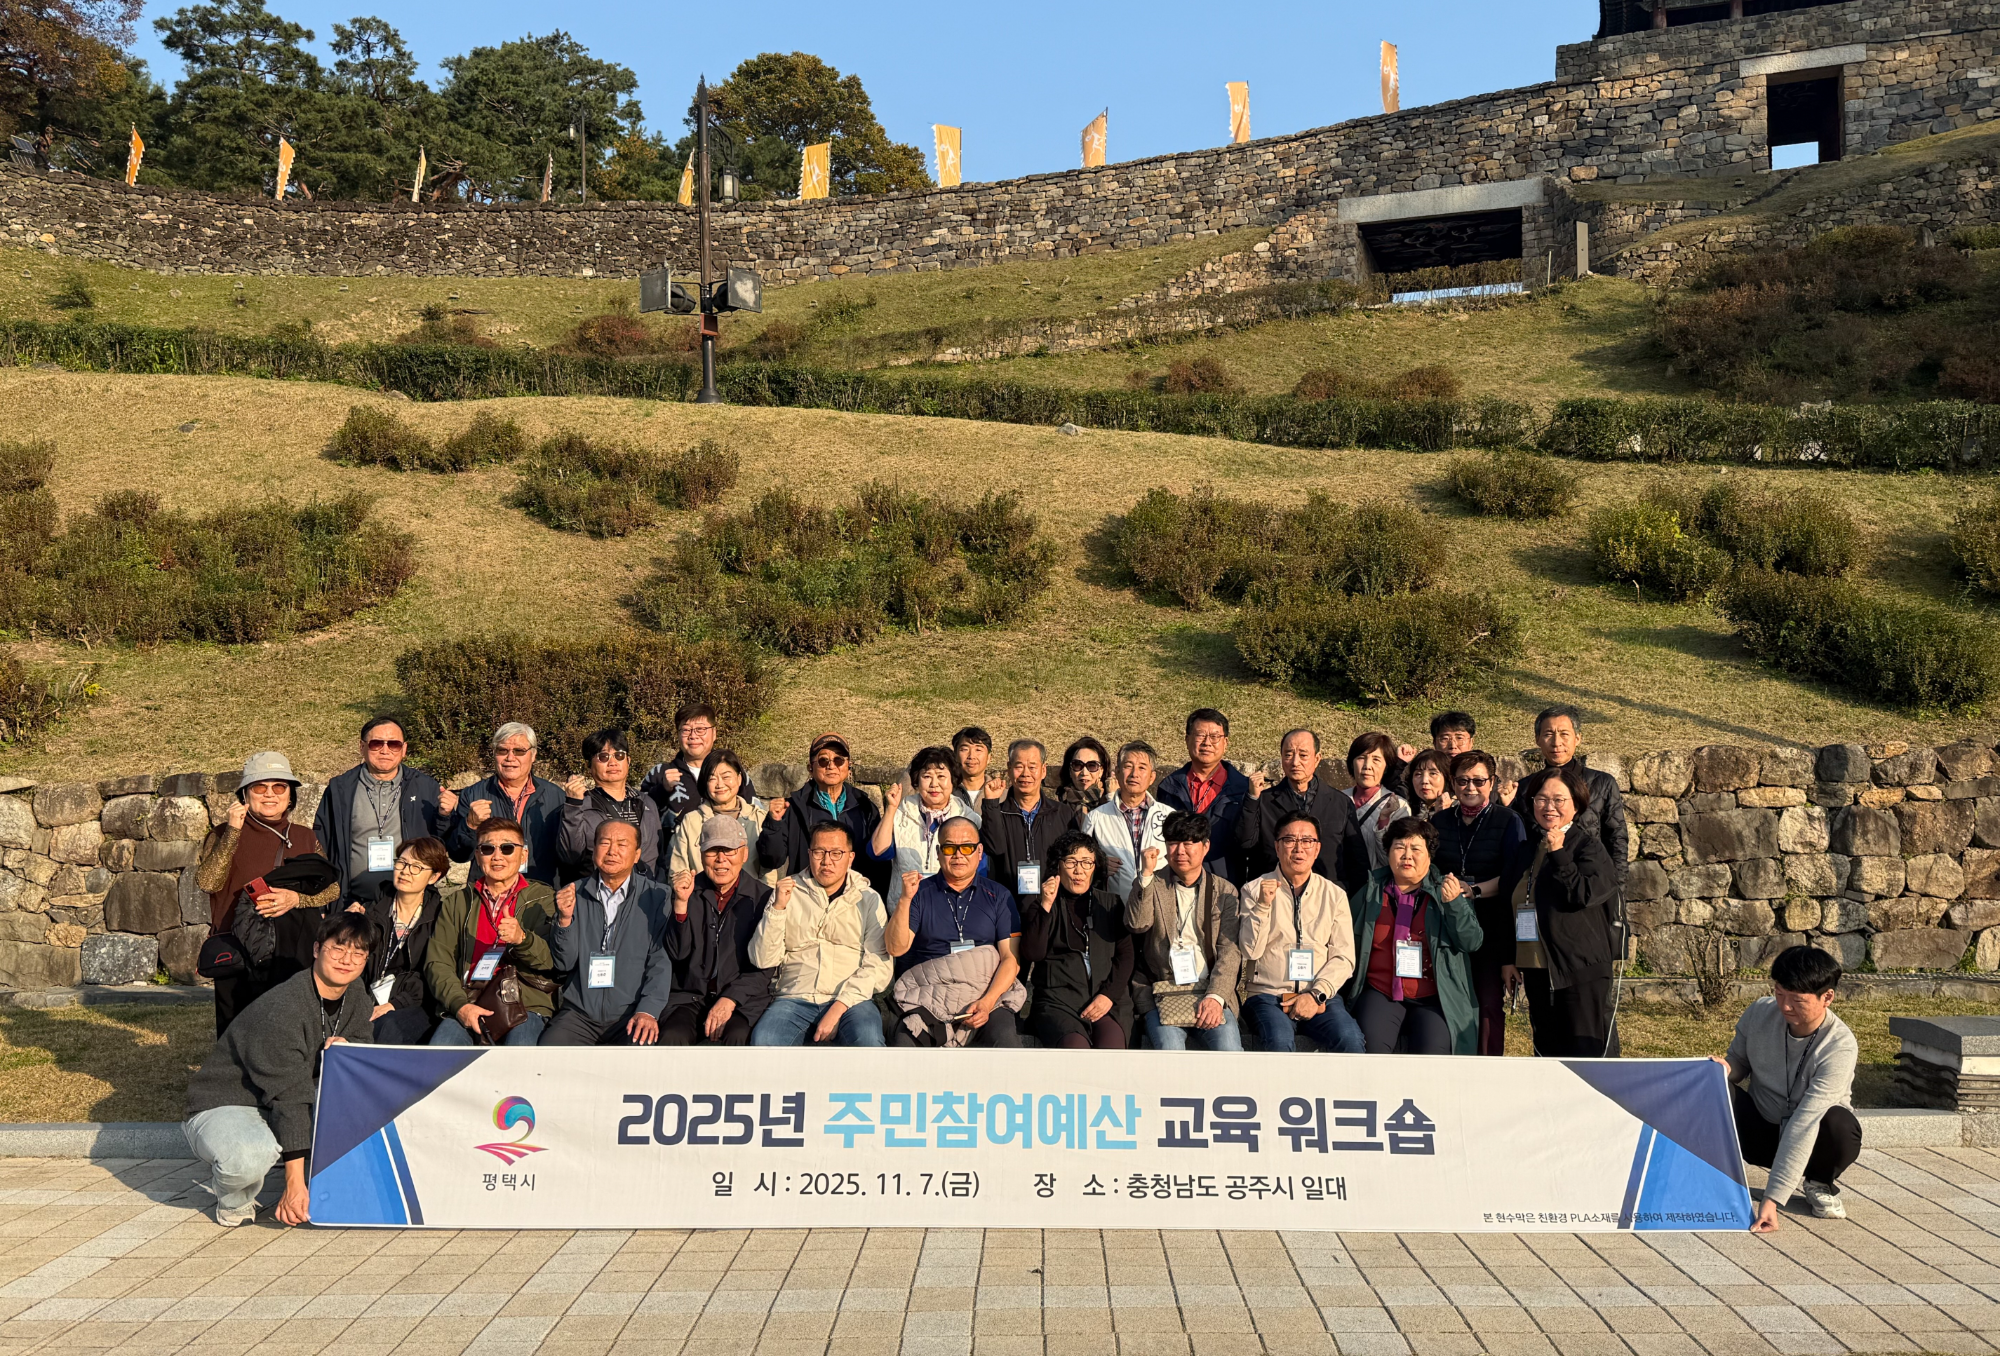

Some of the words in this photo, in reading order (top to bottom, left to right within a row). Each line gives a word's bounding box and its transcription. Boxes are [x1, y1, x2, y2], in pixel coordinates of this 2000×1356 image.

[617, 1091, 806, 1148] 2025년
[823, 1091, 1143, 1151] 주민참여예산
[1157, 1095, 1262, 1153] 교육
[1277, 1096, 1437, 1156] 워크숍
[482, 1173, 536, 1192] 평택시
[1126, 1173, 1220, 1200] 충청남도
[1224, 1175, 1294, 1201] 공주시
[1301, 1175, 1348, 1201] 일대
[1483, 1212, 1494, 1223] 본
[1496, 1212, 1536, 1223] 현수막은
[1538, 1212, 1568, 1224] 친환경
[1570, 1212, 1619, 1224] PLA소재를
[1665, 1212, 1740, 1224] 제작하였습니다.
